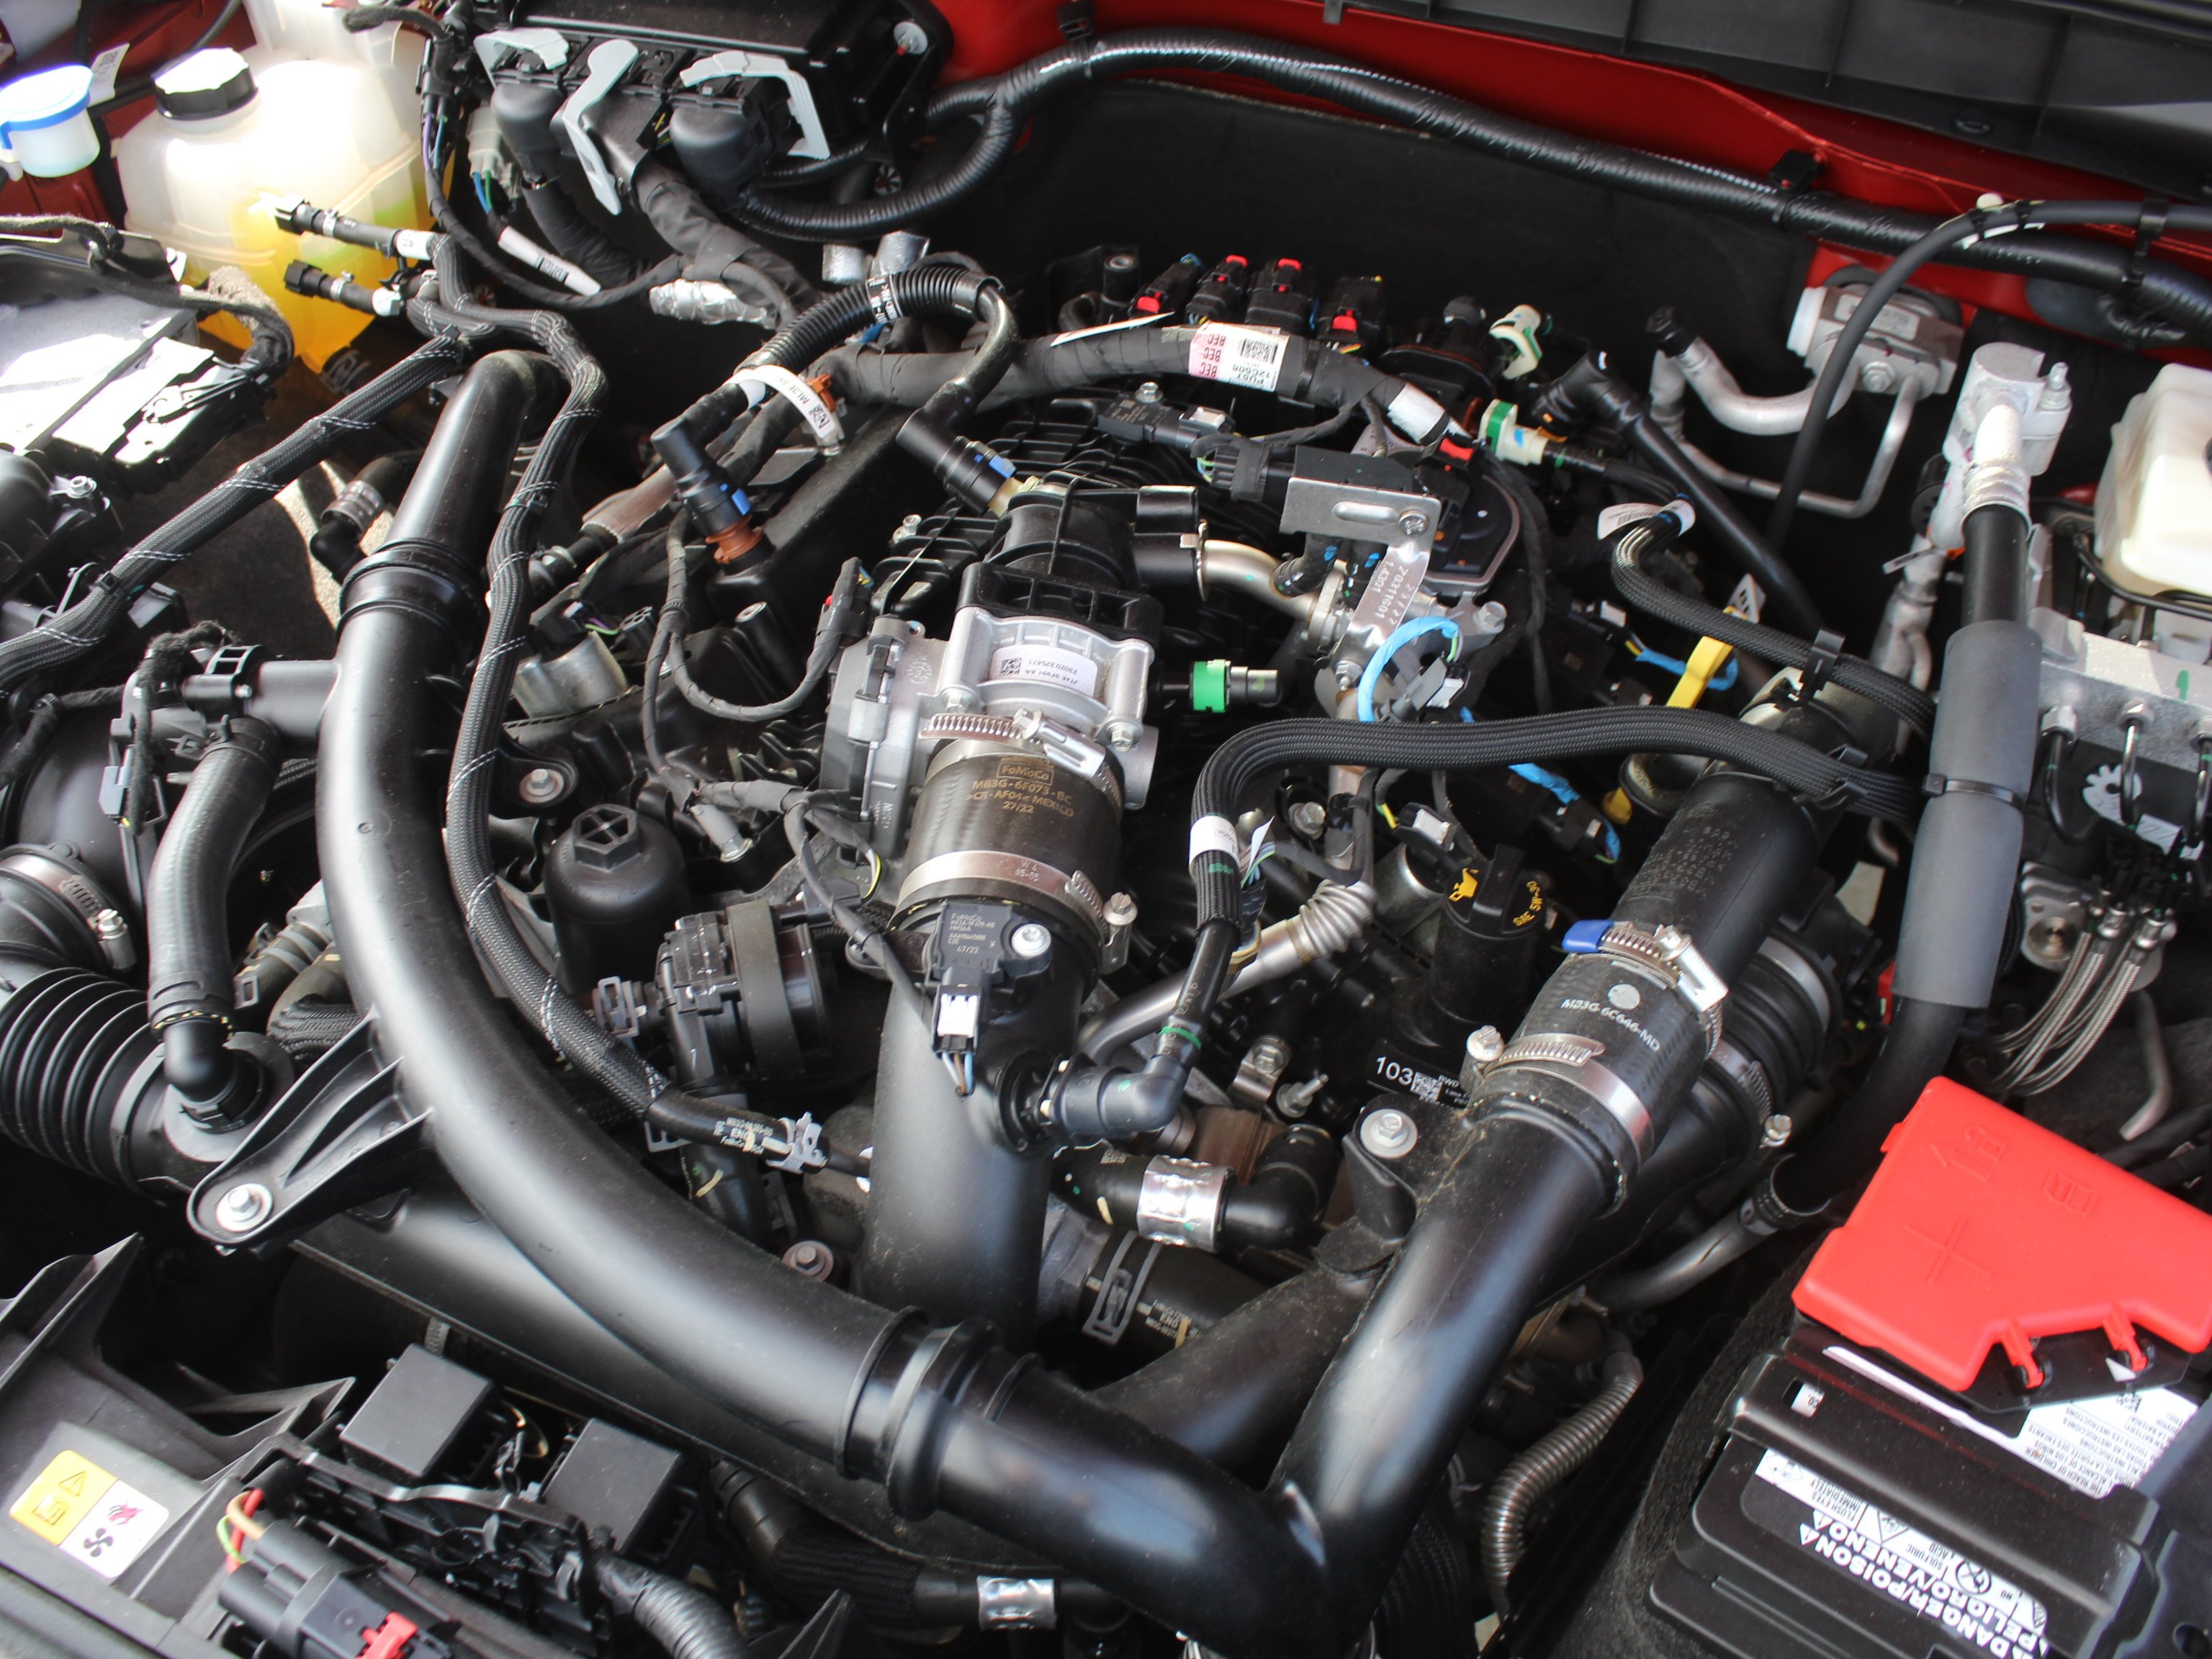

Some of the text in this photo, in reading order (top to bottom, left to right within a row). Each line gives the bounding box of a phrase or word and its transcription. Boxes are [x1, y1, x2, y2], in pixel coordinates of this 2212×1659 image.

[1208, 333, 1225, 344] BEC
[1204, 348, 1220, 360] BEC
[1199, 362, 1216, 376] BEC
[1002, 765, 1050, 781] FoMoCo
[1002, 800, 1035, 814] 27/22
[1032, 795, 1075, 817] MEXICO
[1513, 881, 1543, 926] SAE 5W-30
[1376, 1056, 1413, 1086] 103
[2054, 1452, 2067, 1462] LOS
[2080, 1439, 2124, 1466] INSTRUCTIONS
[2067, 1470, 2089, 1485] REACH
[1809, 1479, 1861, 1512] IMMEDIATELY
[2090, 1483, 2102, 1493] THE
[1810, 1491, 1830, 1506] EYES
[1830, 1503, 1856, 1521] FLUSH
[1905, 1543, 1943, 1570] SULFURIC
[1928, 1542, 1948, 1559] ACID
[1829, 1521, 2039, 1653] PELIGRO/VENENO
[1815, 1538, 2011, 1658] DANGER/POISON
